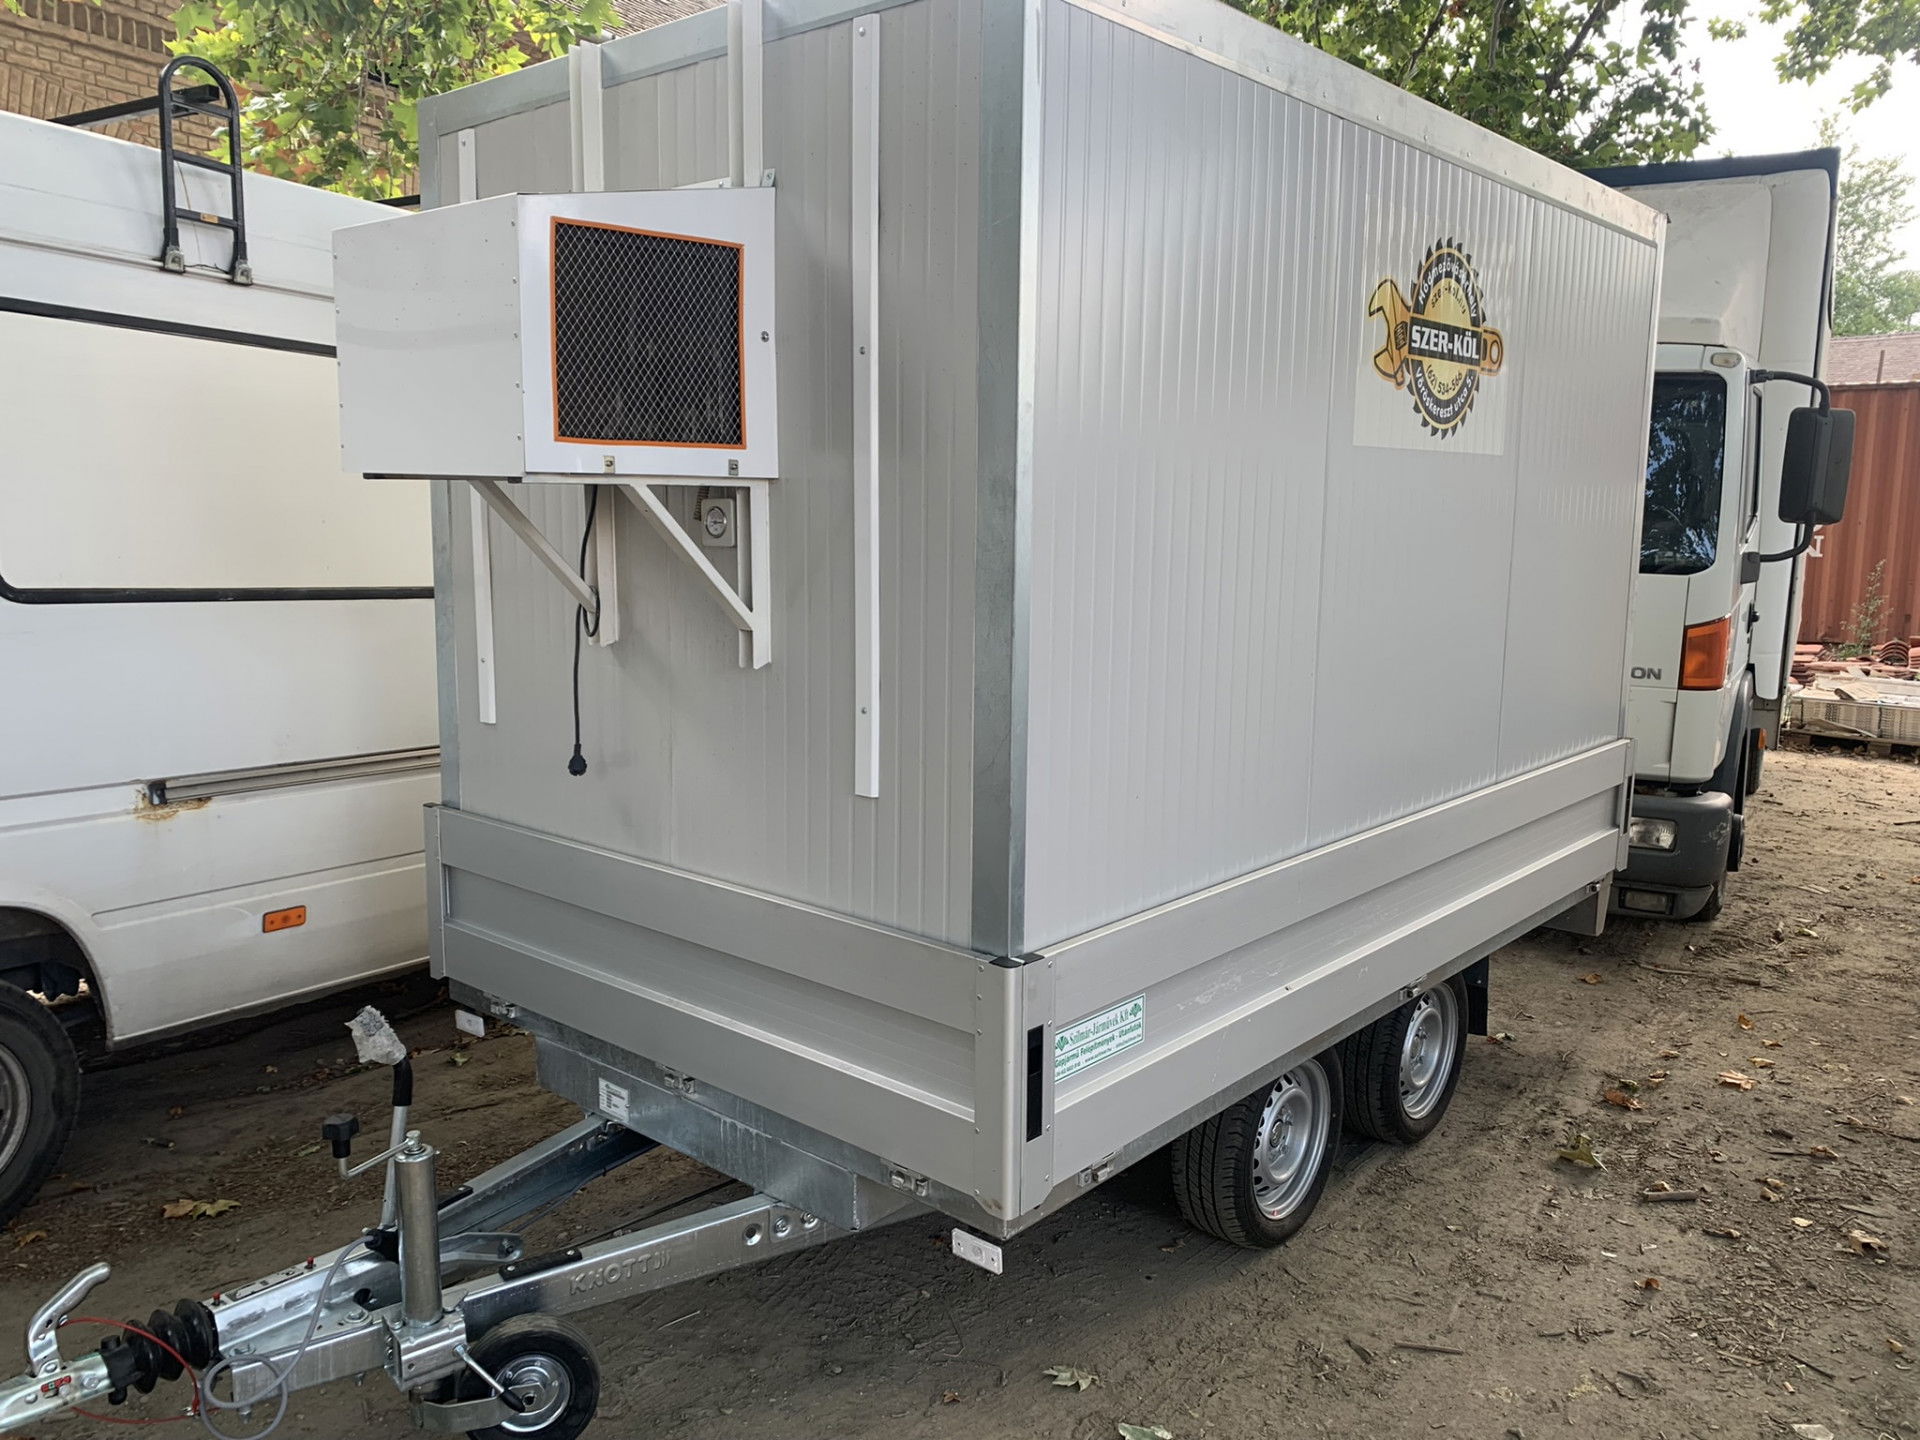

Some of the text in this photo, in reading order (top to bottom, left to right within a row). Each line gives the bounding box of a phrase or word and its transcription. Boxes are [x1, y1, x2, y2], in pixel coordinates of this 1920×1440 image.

[1411, 325, 1480, 360] SZER-KÖL
[1416, 366, 1453, 418] Vöröskereszt
[1454, 387, 1468, 411] utca
[569, 1253, 652, 1296] KNOTT
